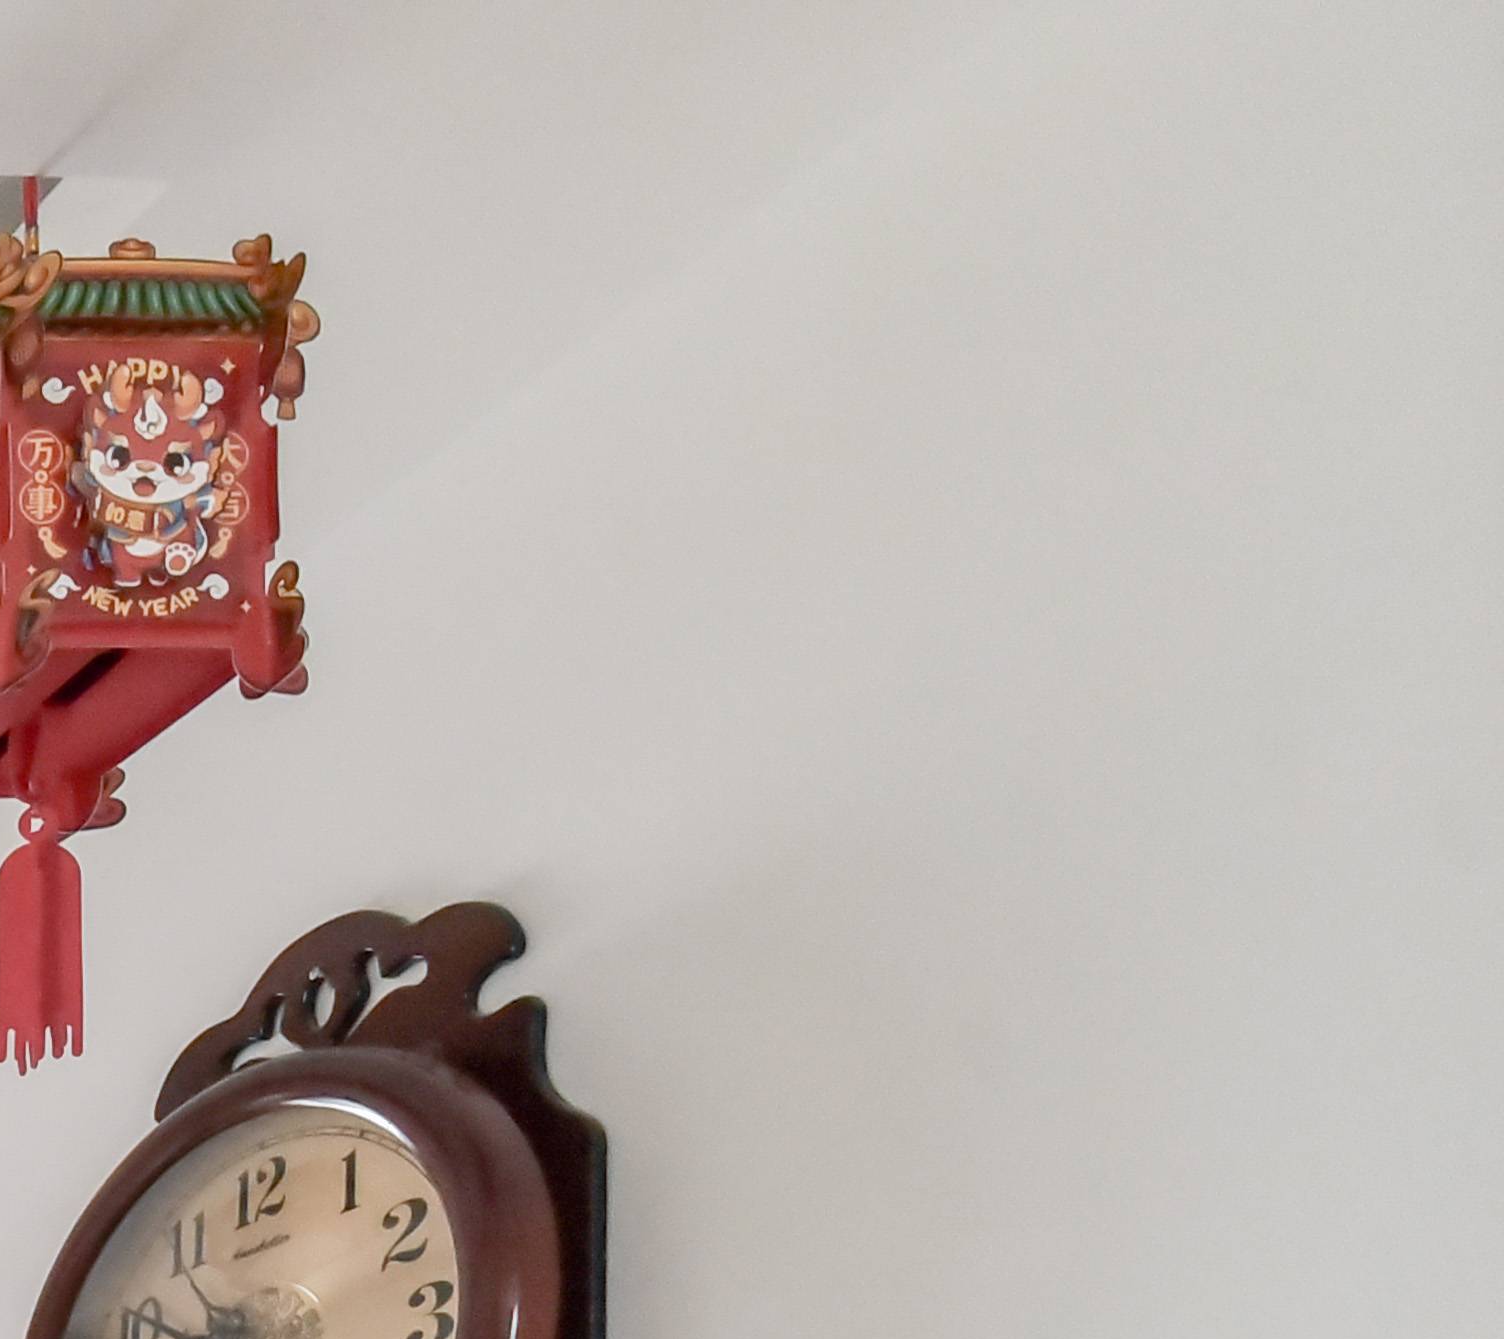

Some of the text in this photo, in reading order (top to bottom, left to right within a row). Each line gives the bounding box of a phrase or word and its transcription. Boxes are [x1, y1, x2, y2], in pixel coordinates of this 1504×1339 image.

[25, 437, 58, 521] 万事
[81, 584, 200, 617] NEW YEAR
[234, 1155, 287, 1231] 12
[339, 1148, 361, 1215] 1
[169, 1209, 207, 1278] 11
[380, 1197, 431, 1272] 2
